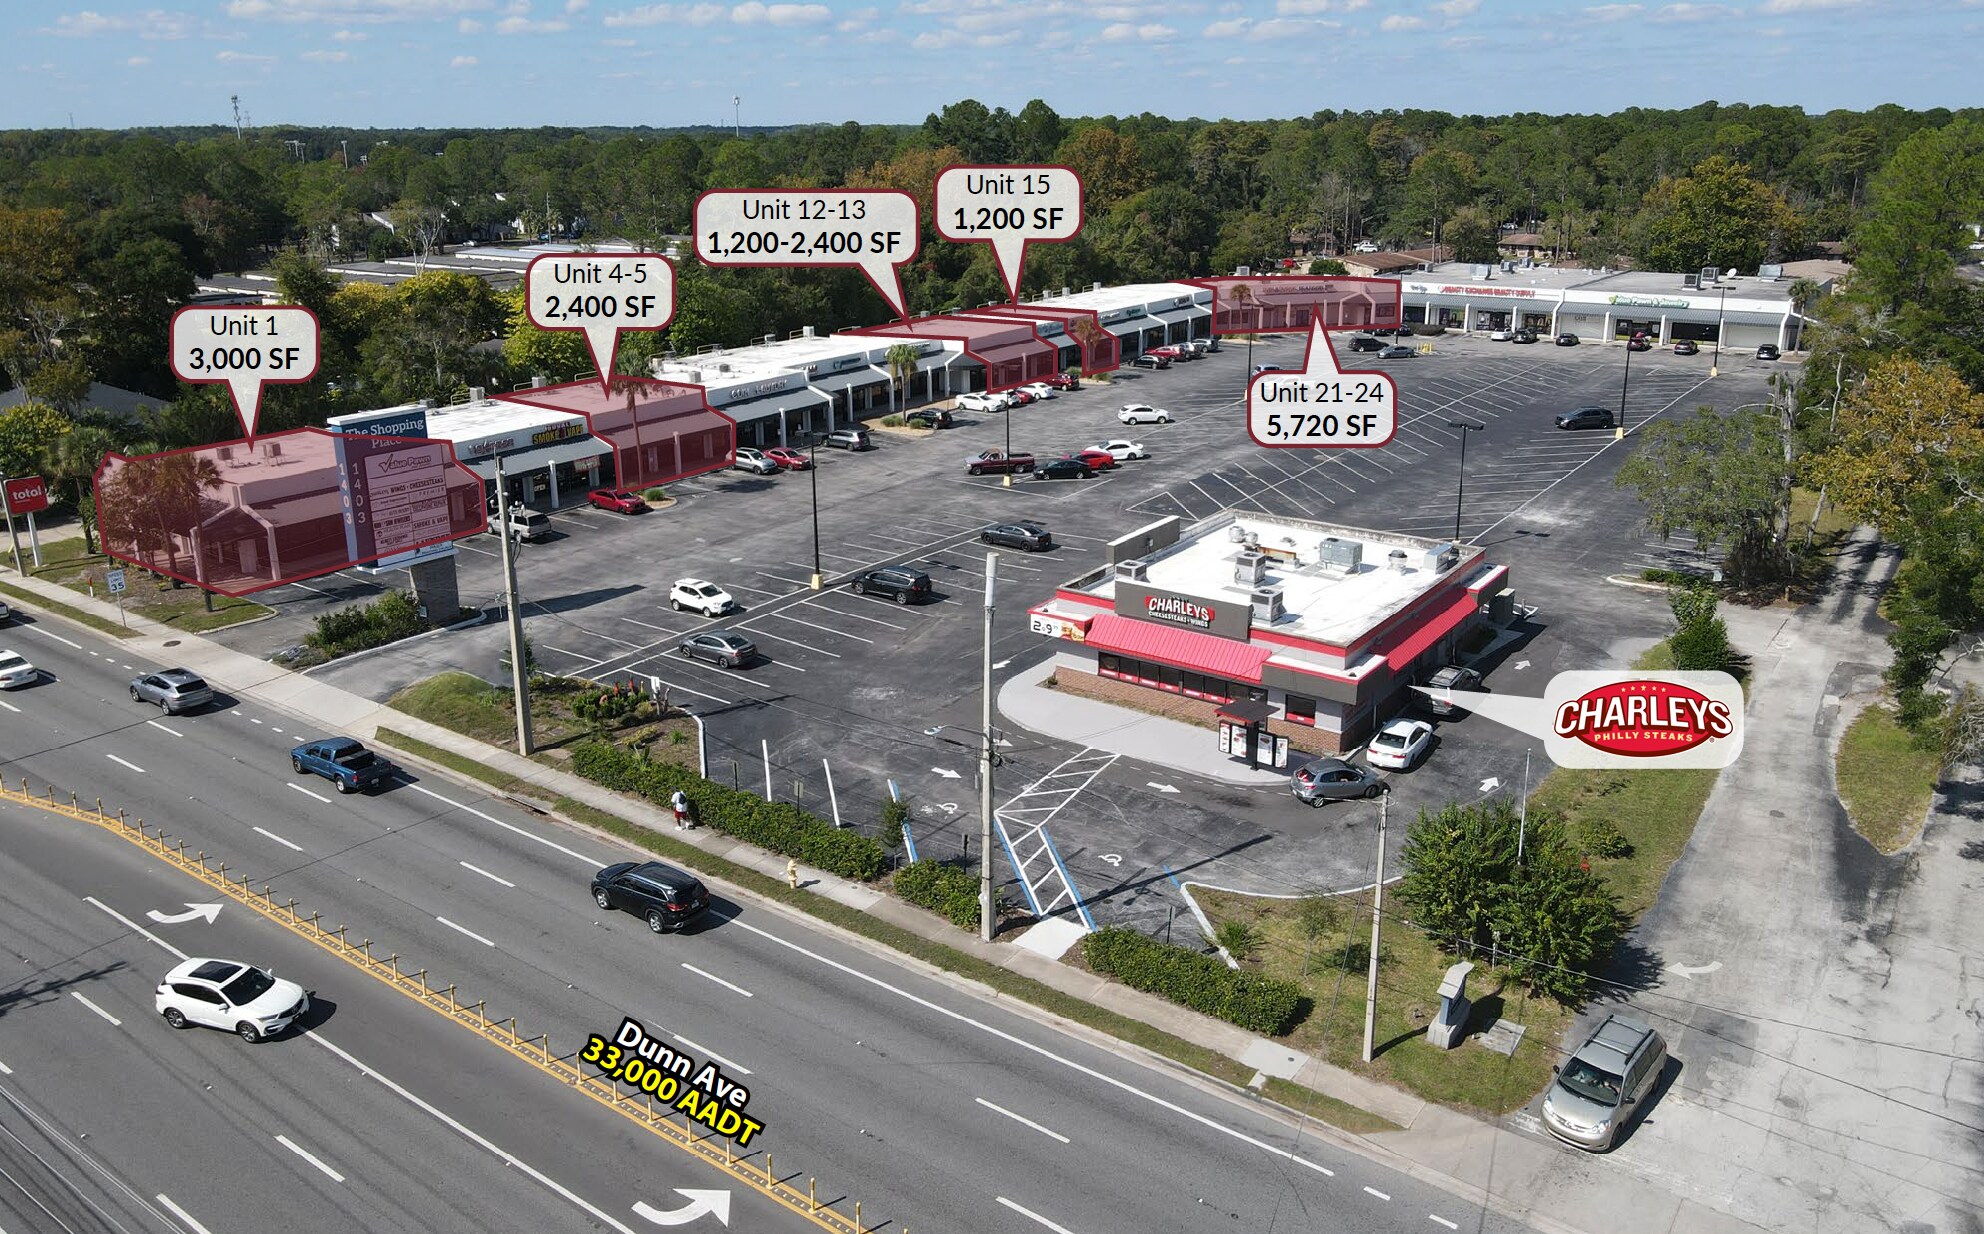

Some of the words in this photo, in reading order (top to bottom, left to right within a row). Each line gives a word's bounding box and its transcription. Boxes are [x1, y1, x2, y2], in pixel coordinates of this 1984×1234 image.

[345, 428, 368, 441] The
[370, 419, 424, 436] Shopping
[532, 430, 560, 445] SMOKE
[378, 453, 407, 473] Value
[407, 455, 432, 467] Pawn
[12, 485, 42, 500] total
[338, 464, 353, 525] 1403
[351, 462, 367, 524] 1403
[390, 485, 406, 494] WINGS
[111, 581, 125, 591] 35
[1149, 597, 1210, 621] CHARLEYS
[1033, 620, 1041, 631] 2
